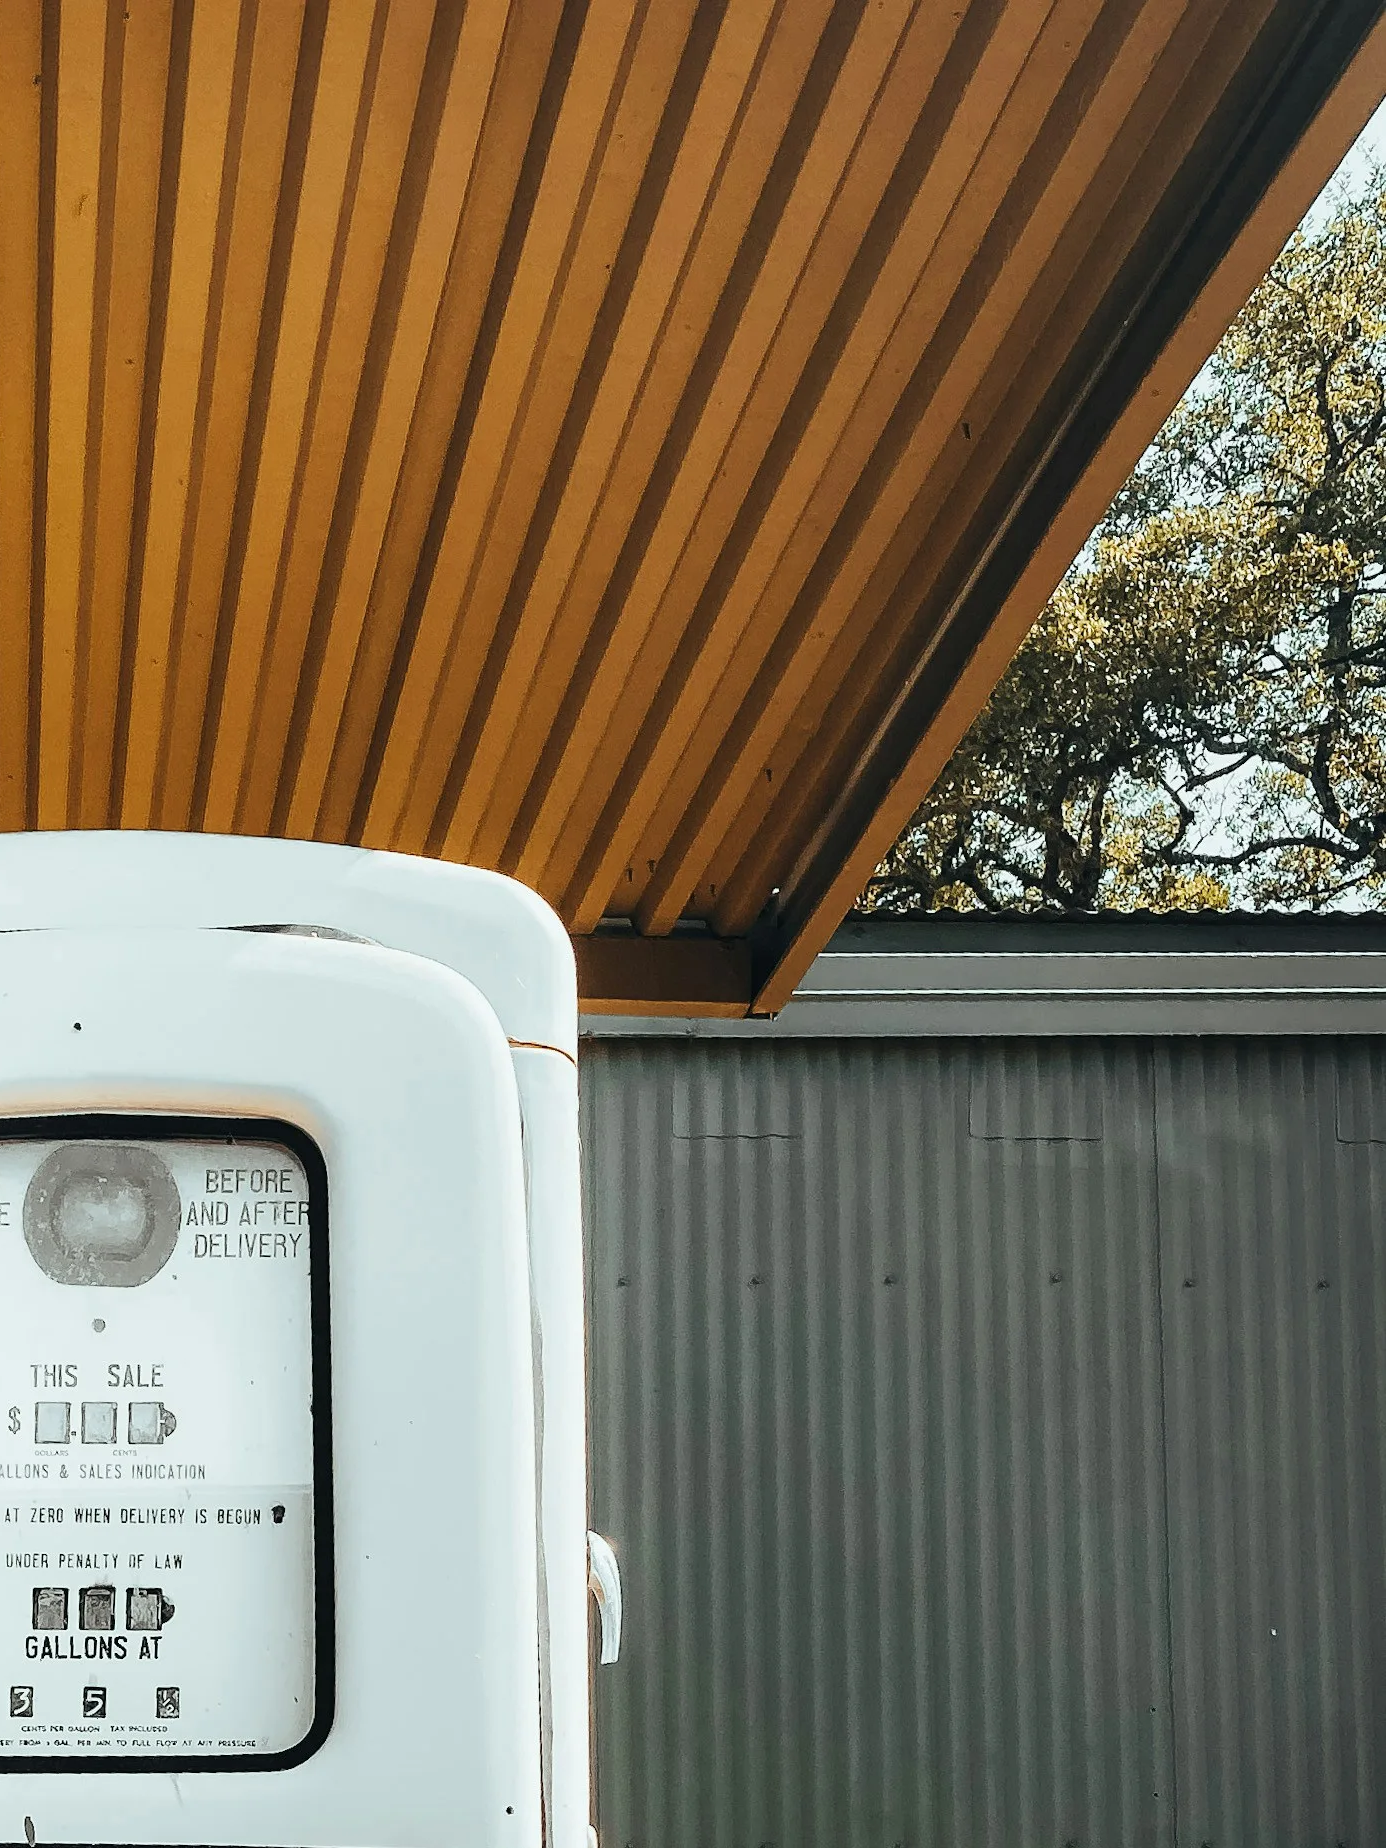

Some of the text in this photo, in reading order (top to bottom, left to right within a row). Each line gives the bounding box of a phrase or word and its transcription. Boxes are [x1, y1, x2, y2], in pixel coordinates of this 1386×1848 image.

[205, 1168, 293, 1194] BEFORE
[185, 1200, 309, 1227] AND AFTER
[194, 1233, 303, 1258] DELIVERY
[30, 1363, 164, 1388] THIS SALE
[7, 1405, 21, 1435] $
[34, 1449, 70, 1457] DOLLARS
[59, 1463, 69, 1479] &
[79, 1463, 122, 1480] SALES
[131, 1464, 206, 1480] INDICATION
[4, 1507, 20, 1523] AT
[30, 1507, 64, 1524] ZERO
[74, 1507, 111, 1524] WHEN
[120, 1508, 185, 1525] DELIVERY
[195, 1508, 207, 1524] IS
[217, 1508, 261, 1525] BEGUN
[6, 1553, 183, 1570] UNDER PENALTY OF LAW
[25, 1635, 163, 1661] GALLONS AT
[13, 1687, 32, 1715] 3
[86, 1689, 104, 1717] 5
